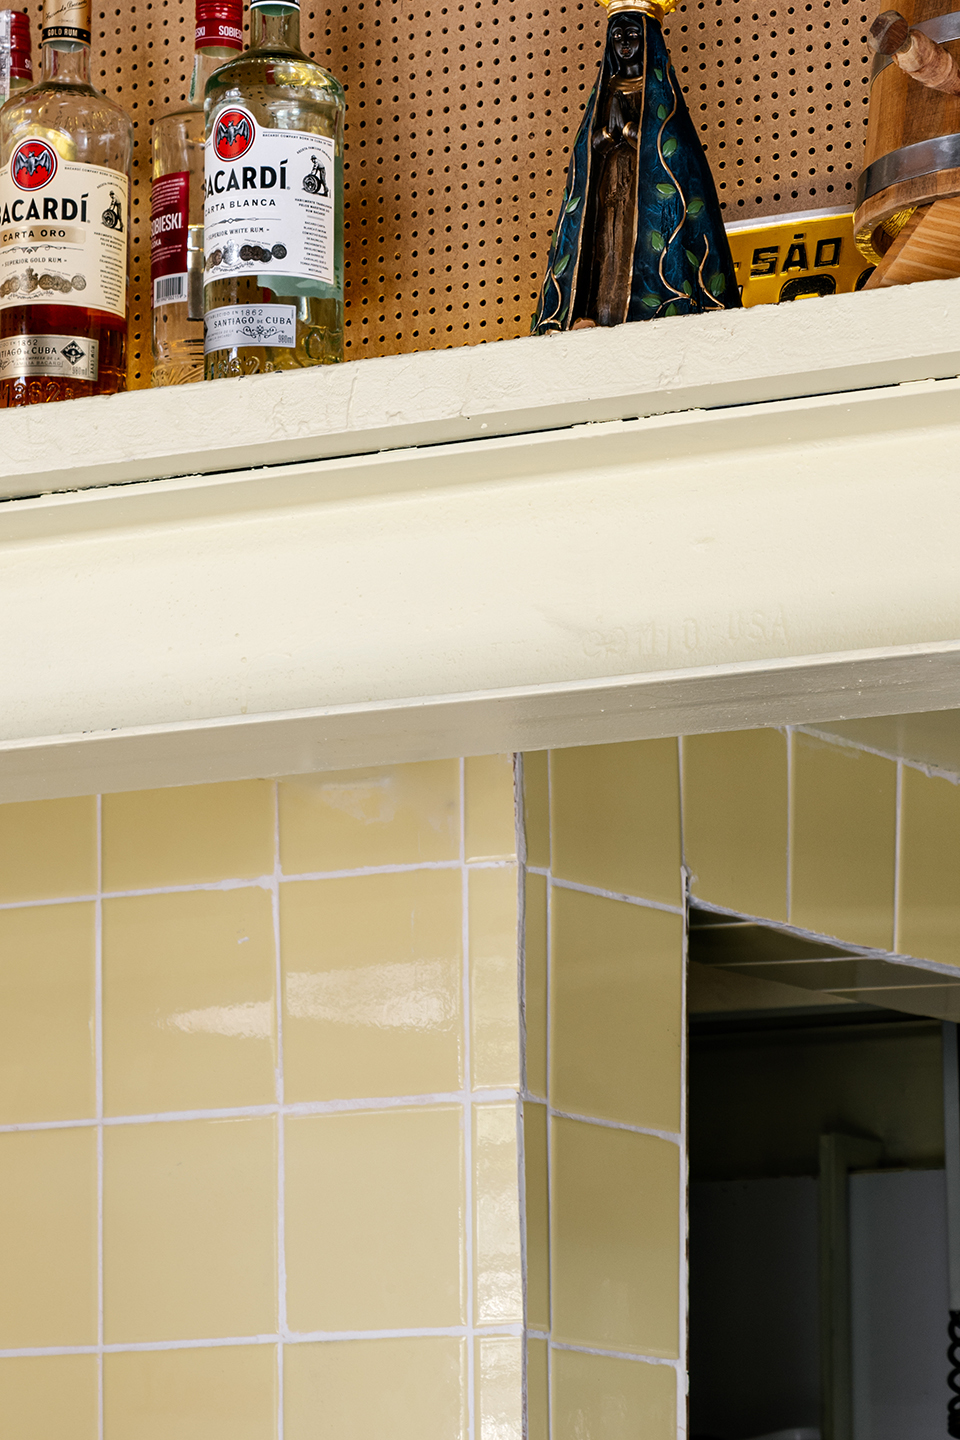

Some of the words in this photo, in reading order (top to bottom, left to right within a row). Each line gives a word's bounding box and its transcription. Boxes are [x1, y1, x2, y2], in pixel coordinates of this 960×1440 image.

[47, 28, 62, 37] GOLD
[64, 28, 78, 37] RUM
[205, 158, 288, 199] ACARDÍ
[0, 193, 89, 226] ACARDÍ
[229, 199, 276, 209] BLANCA
[151, 212, 182, 238] OBIESKI
[230, 227, 248, 235] WHITE
[3, 230, 35, 242] CARTA
[40, 229, 66, 237] ORO
[750, 233, 842, 278] SÃO
[213, 316, 254, 328] SANTIAGO
[265, 317, 292, 325] CUBA
